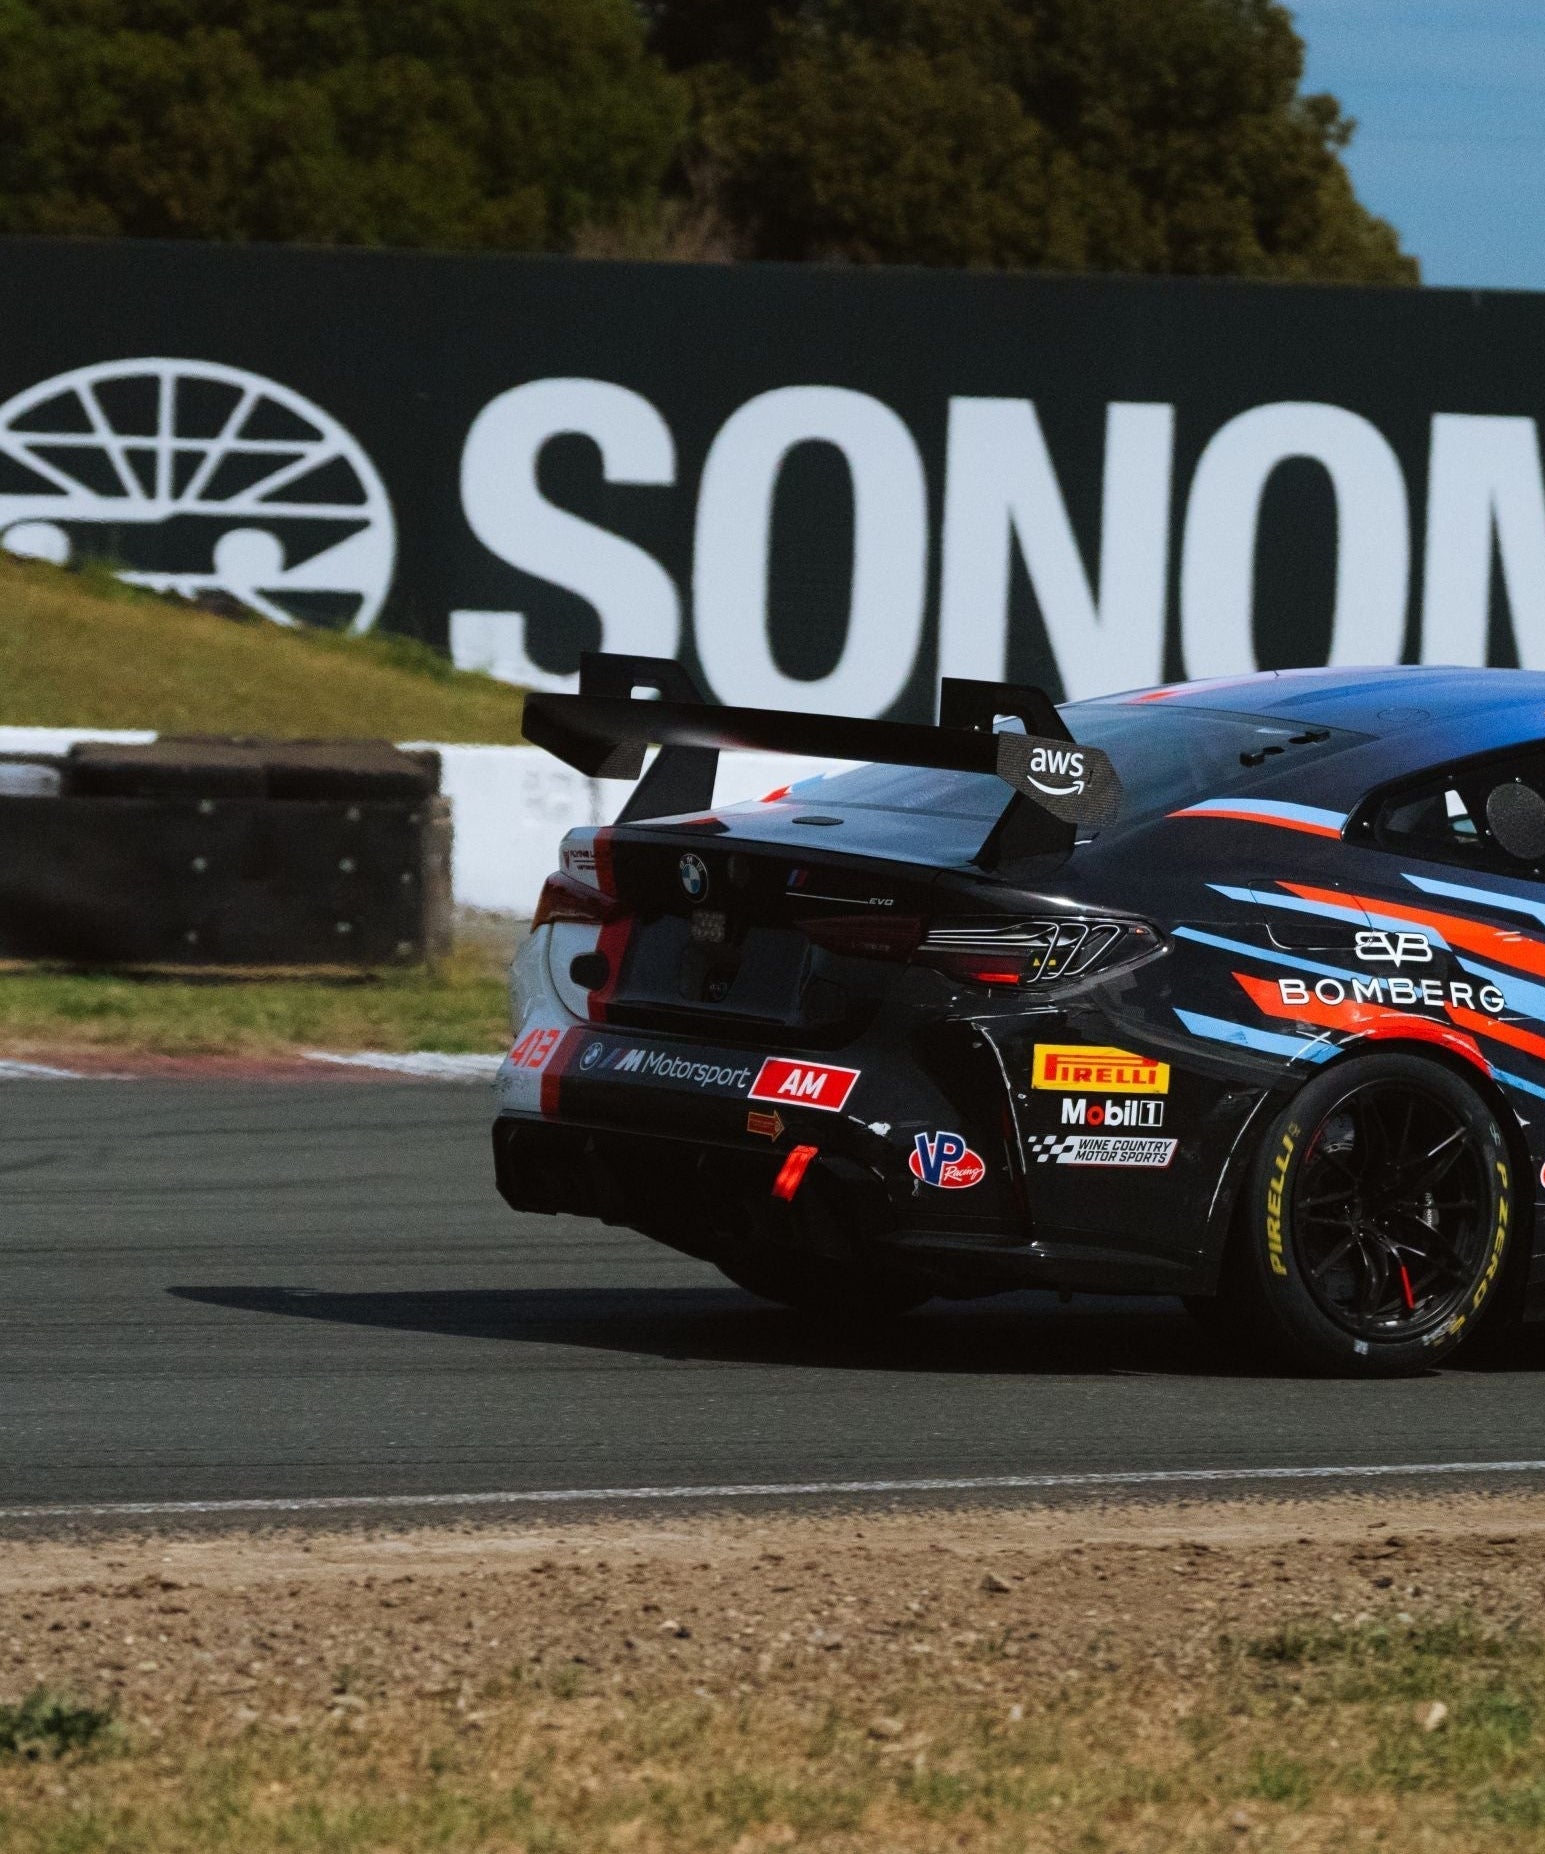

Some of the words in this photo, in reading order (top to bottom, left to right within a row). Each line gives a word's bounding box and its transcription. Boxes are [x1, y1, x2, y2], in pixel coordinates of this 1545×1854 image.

[1030, 747, 1084, 777] aws
[868, 897, 894, 906] EVO
[1278, 977, 1506, 1013] BOMBERG
[510, 1028, 561, 1069] 413
[642, 1051, 751, 1089] Motorsport
[778, 1069, 828, 1099] AM
[1043, 1053, 1160, 1085] PIRELLI
[1060, 1098, 1138, 1127] Mobil
[914, 1131, 966, 1187] VP
[1074, 1150, 1116, 1162] MOTOR
[1118, 1152, 1168, 1164] SPORTS
[1078, 1138, 1111, 1151] WINE
[1112, 1139, 1173, 1153] COUNTRY
[944, 1165, 984, 1182] Racing
[1265, 1135, 1295, 1276] PIRELLI
[1473, 1196, 1510, 1309] ZERO
